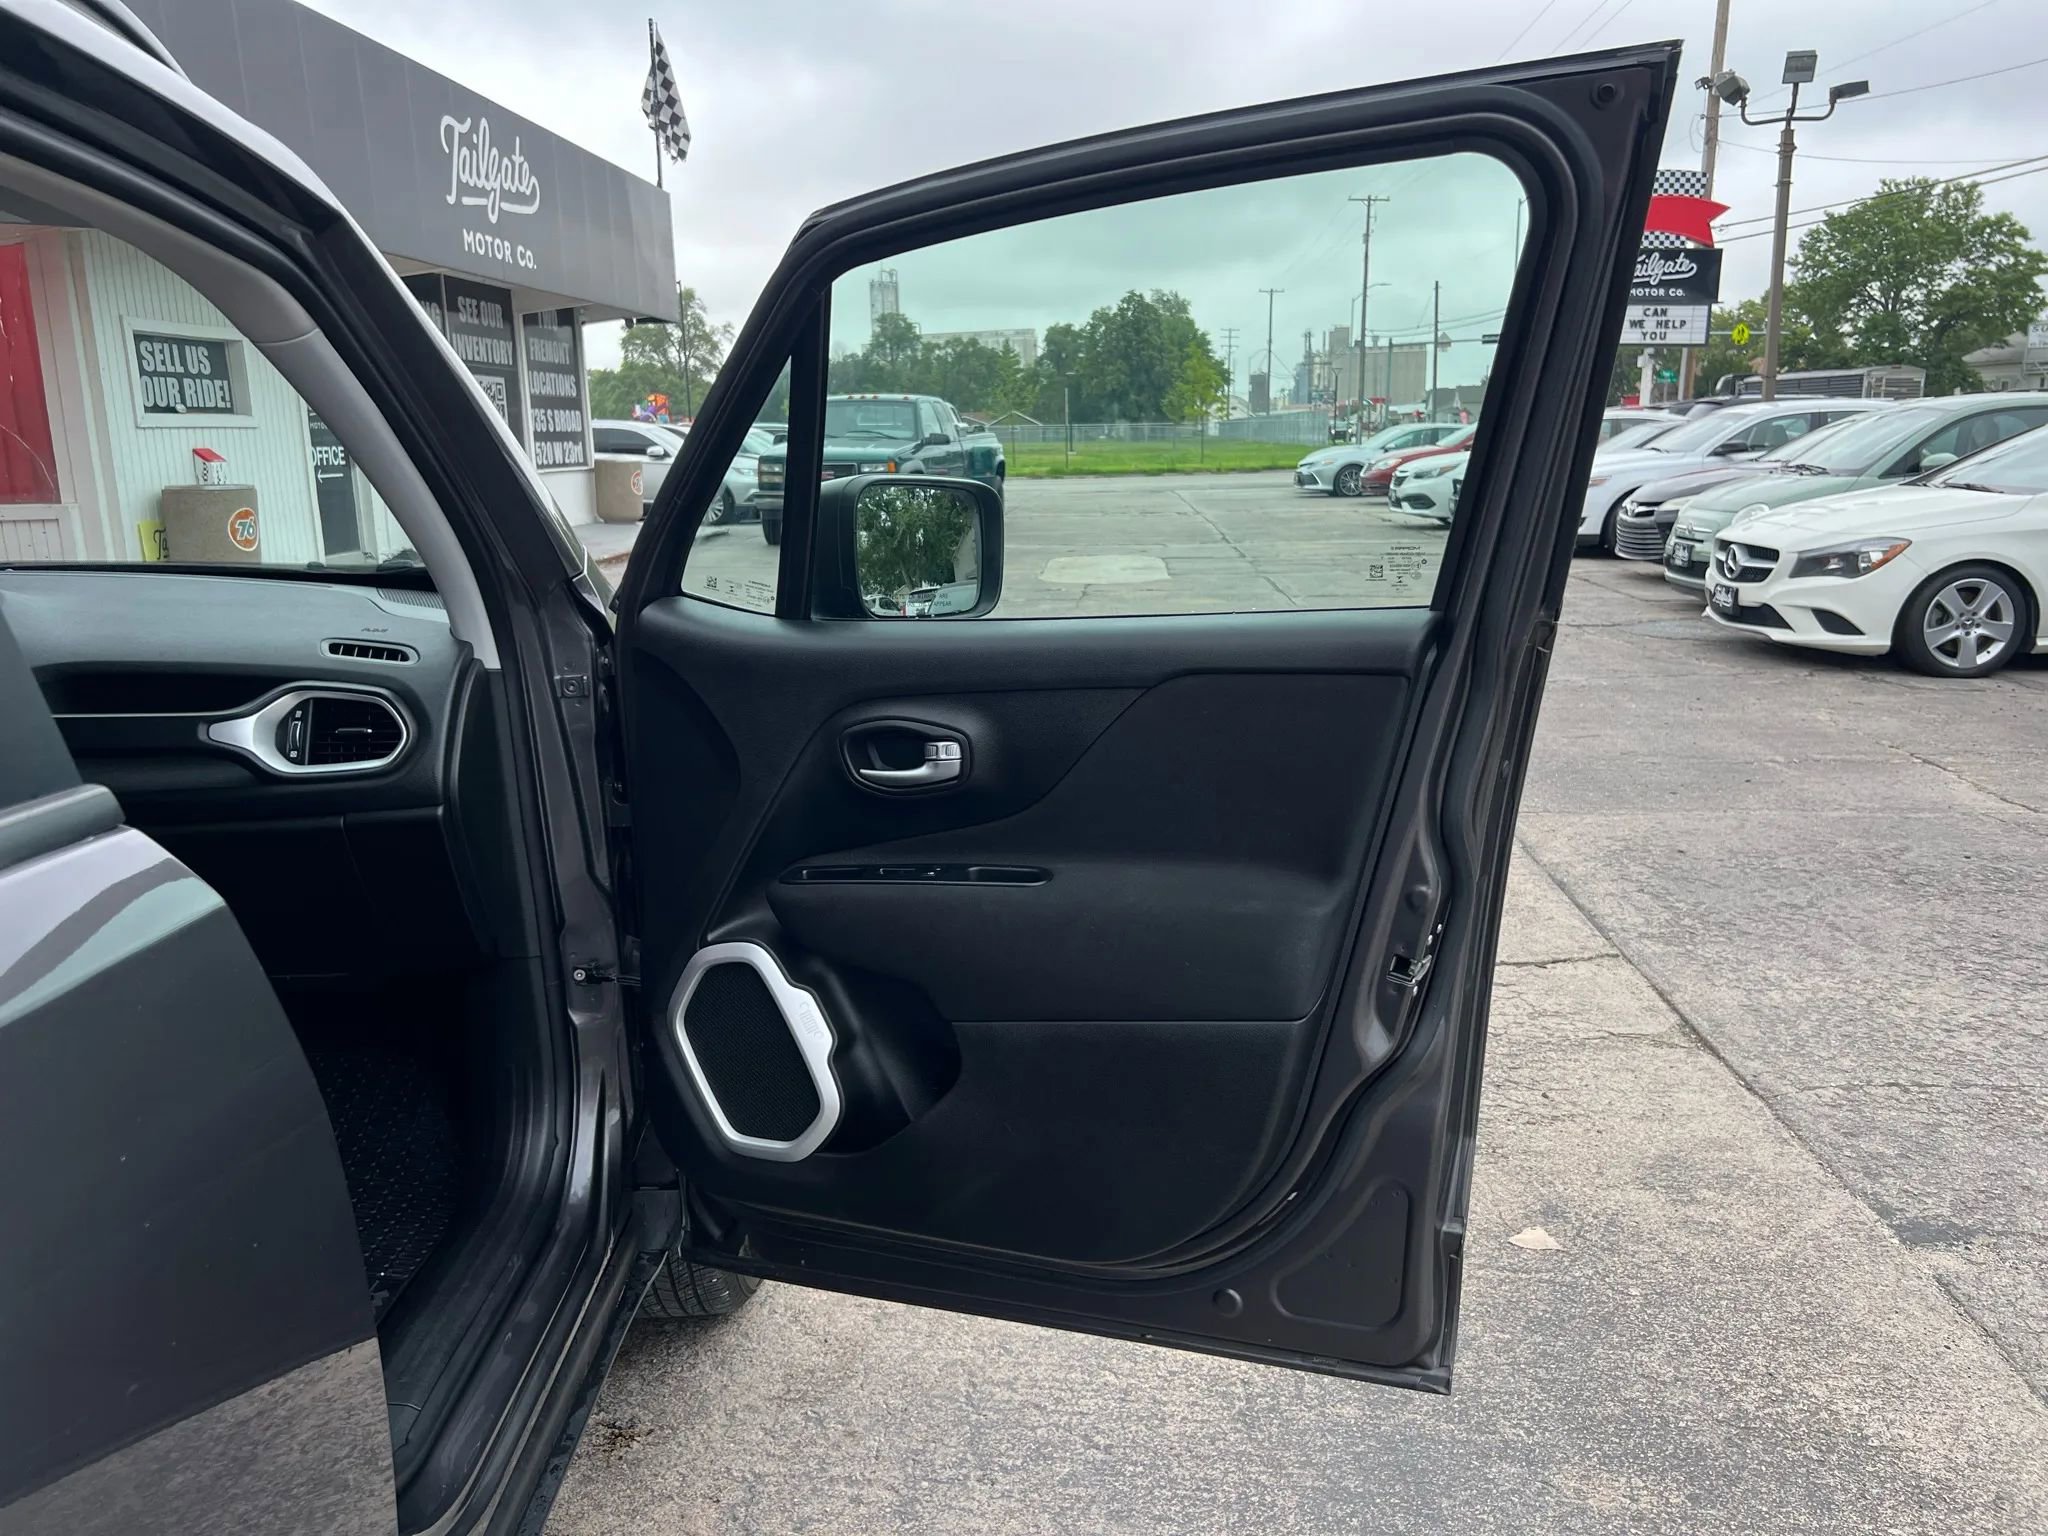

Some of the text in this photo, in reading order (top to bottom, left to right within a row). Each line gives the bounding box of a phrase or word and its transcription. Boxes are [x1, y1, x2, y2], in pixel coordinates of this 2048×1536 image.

[440, 114, 540, 224] Tailgate
[463, 228, 537, 269] MOTOR CO.
[1633, 252, 1697, 285] ailgate
[1669, 288, 1686, 297] CO.
[457, 295, 504, 329] SEE OUR
[1629, 320, 1687, 329] WE HELP
[1643, 308, 1668, 317] CAN
[452, 332, 513, 366] INVENTORY
[1641, 331, 1667, 341] YOU
[139, 340, 212, 375] SELL US
[529, 337, 570, 365] FREMONT
[183, 377, 232, 409] RIDE!
[529, 370, 577, 398] LOCATIONS
[554, 409, 582, 433] BROAD
[535, 441, 554, 466] 520
[553, 441, 564, 464] W
[236, 516, 257, 541] 76
